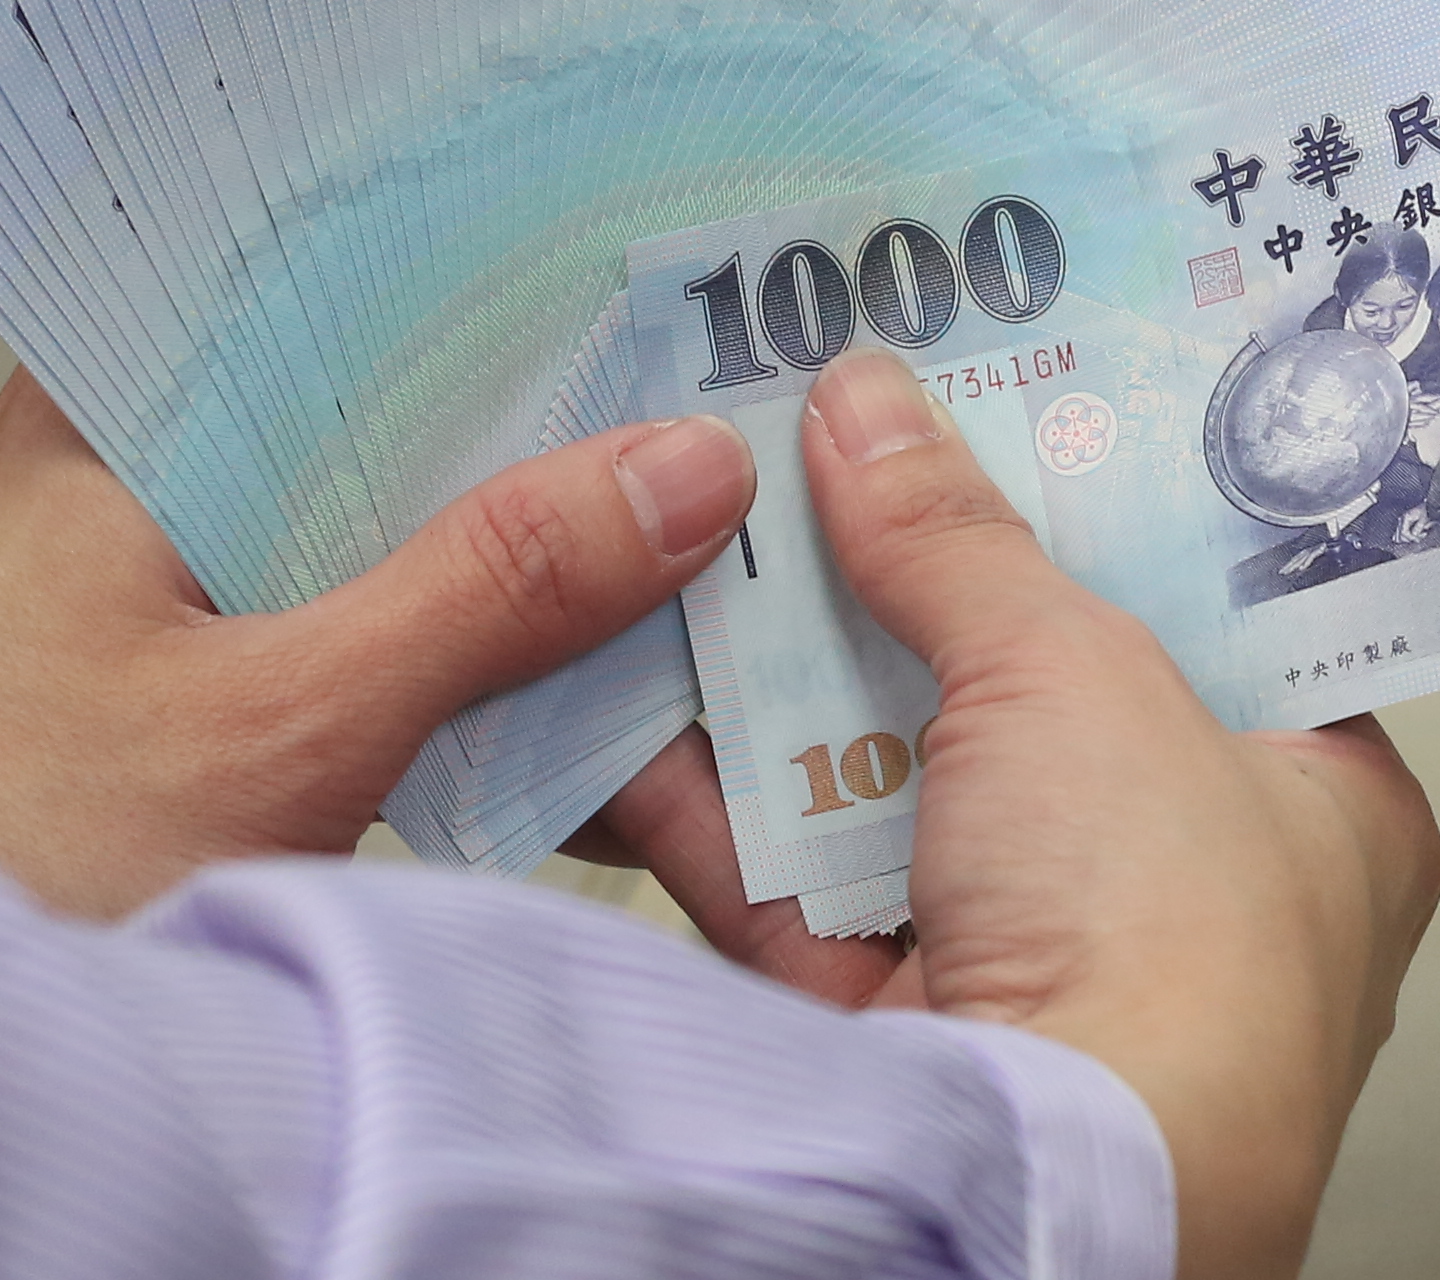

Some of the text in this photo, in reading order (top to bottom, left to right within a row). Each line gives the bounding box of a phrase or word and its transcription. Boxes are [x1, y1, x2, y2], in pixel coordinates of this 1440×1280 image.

[685, 193, 1067, 392] 1000
[918, 341, 1077, 405] 7341GM
[1284, 634, 1412, 688] 中央印製廠
[789, 715, 939, 818] 10
